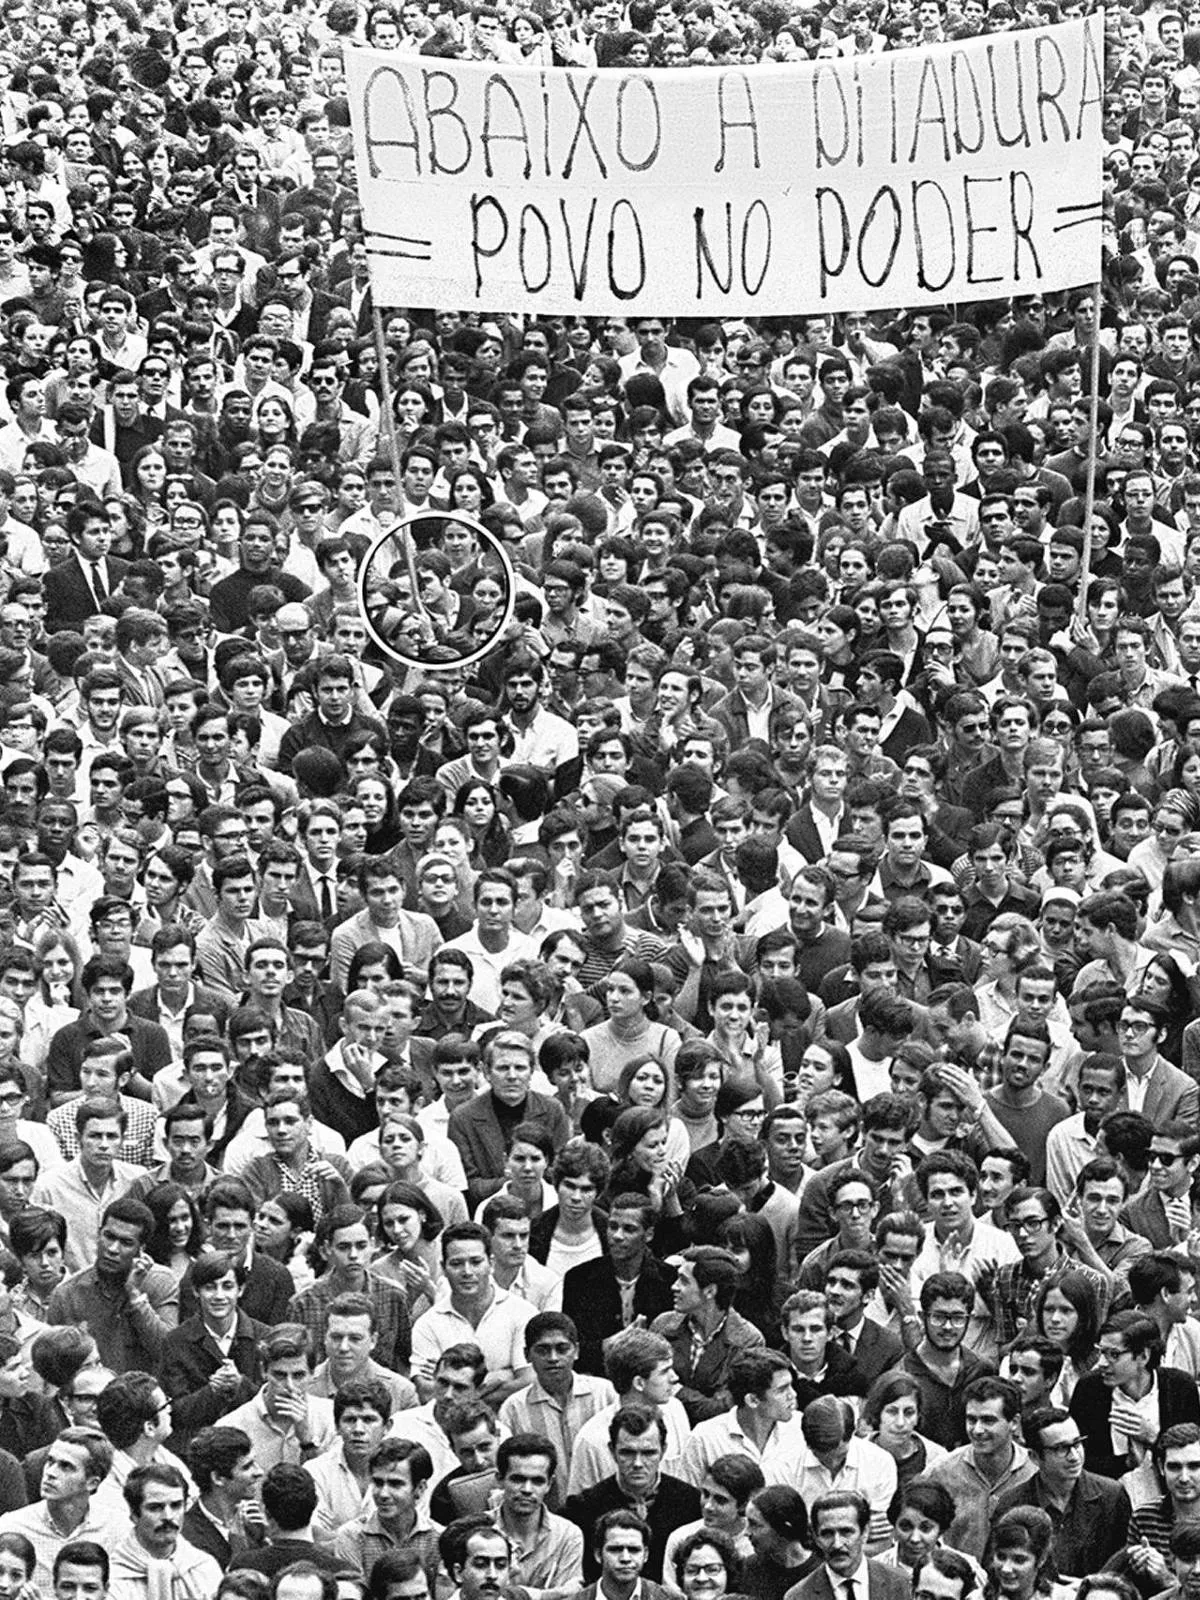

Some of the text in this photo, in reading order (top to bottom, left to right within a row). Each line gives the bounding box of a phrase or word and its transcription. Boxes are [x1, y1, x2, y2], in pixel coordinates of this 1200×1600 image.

[714, 70, 761, 172] A
[469, 169, 1043, 301] POVO NO PODER
